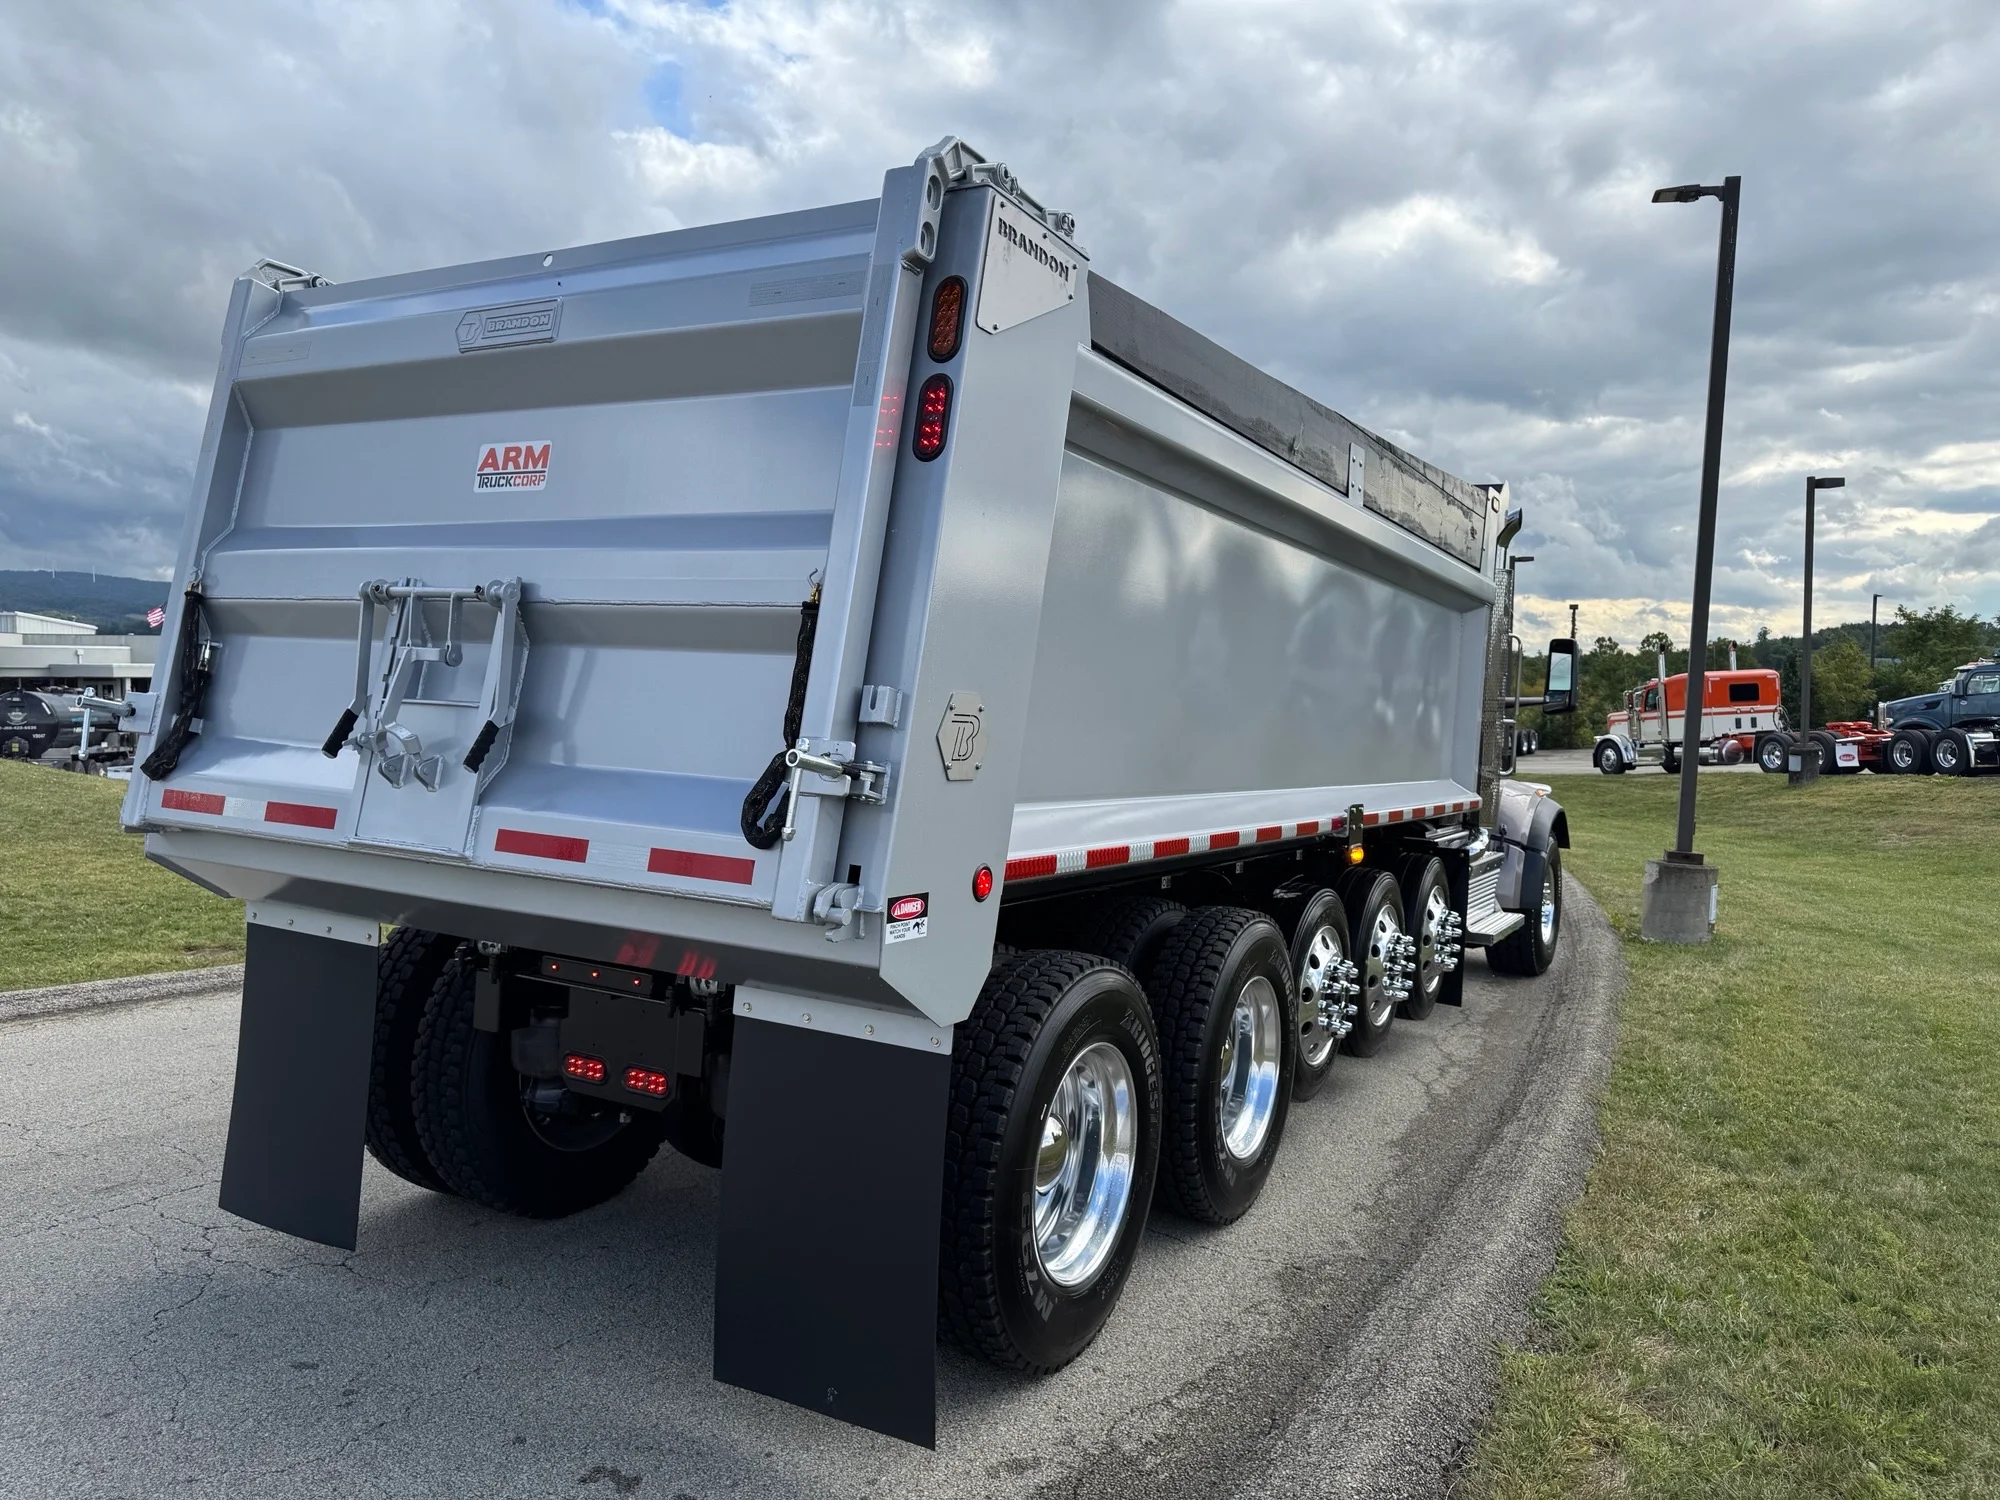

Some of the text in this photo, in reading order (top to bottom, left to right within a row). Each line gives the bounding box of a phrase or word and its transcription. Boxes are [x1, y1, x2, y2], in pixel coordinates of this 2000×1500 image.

[997, 217, 1069, 282] BRANDON
[487, 313, 551, 333] BRANDON
[478, 444, 551, 471] ARM
[477, 473, 546, 489] TRUCKCORP
[900, 900, 922, 914] DANGER
[901, 926, 911, 934] YOUR
[1119, 1007, 1160, 1160] BRIDGESTO
